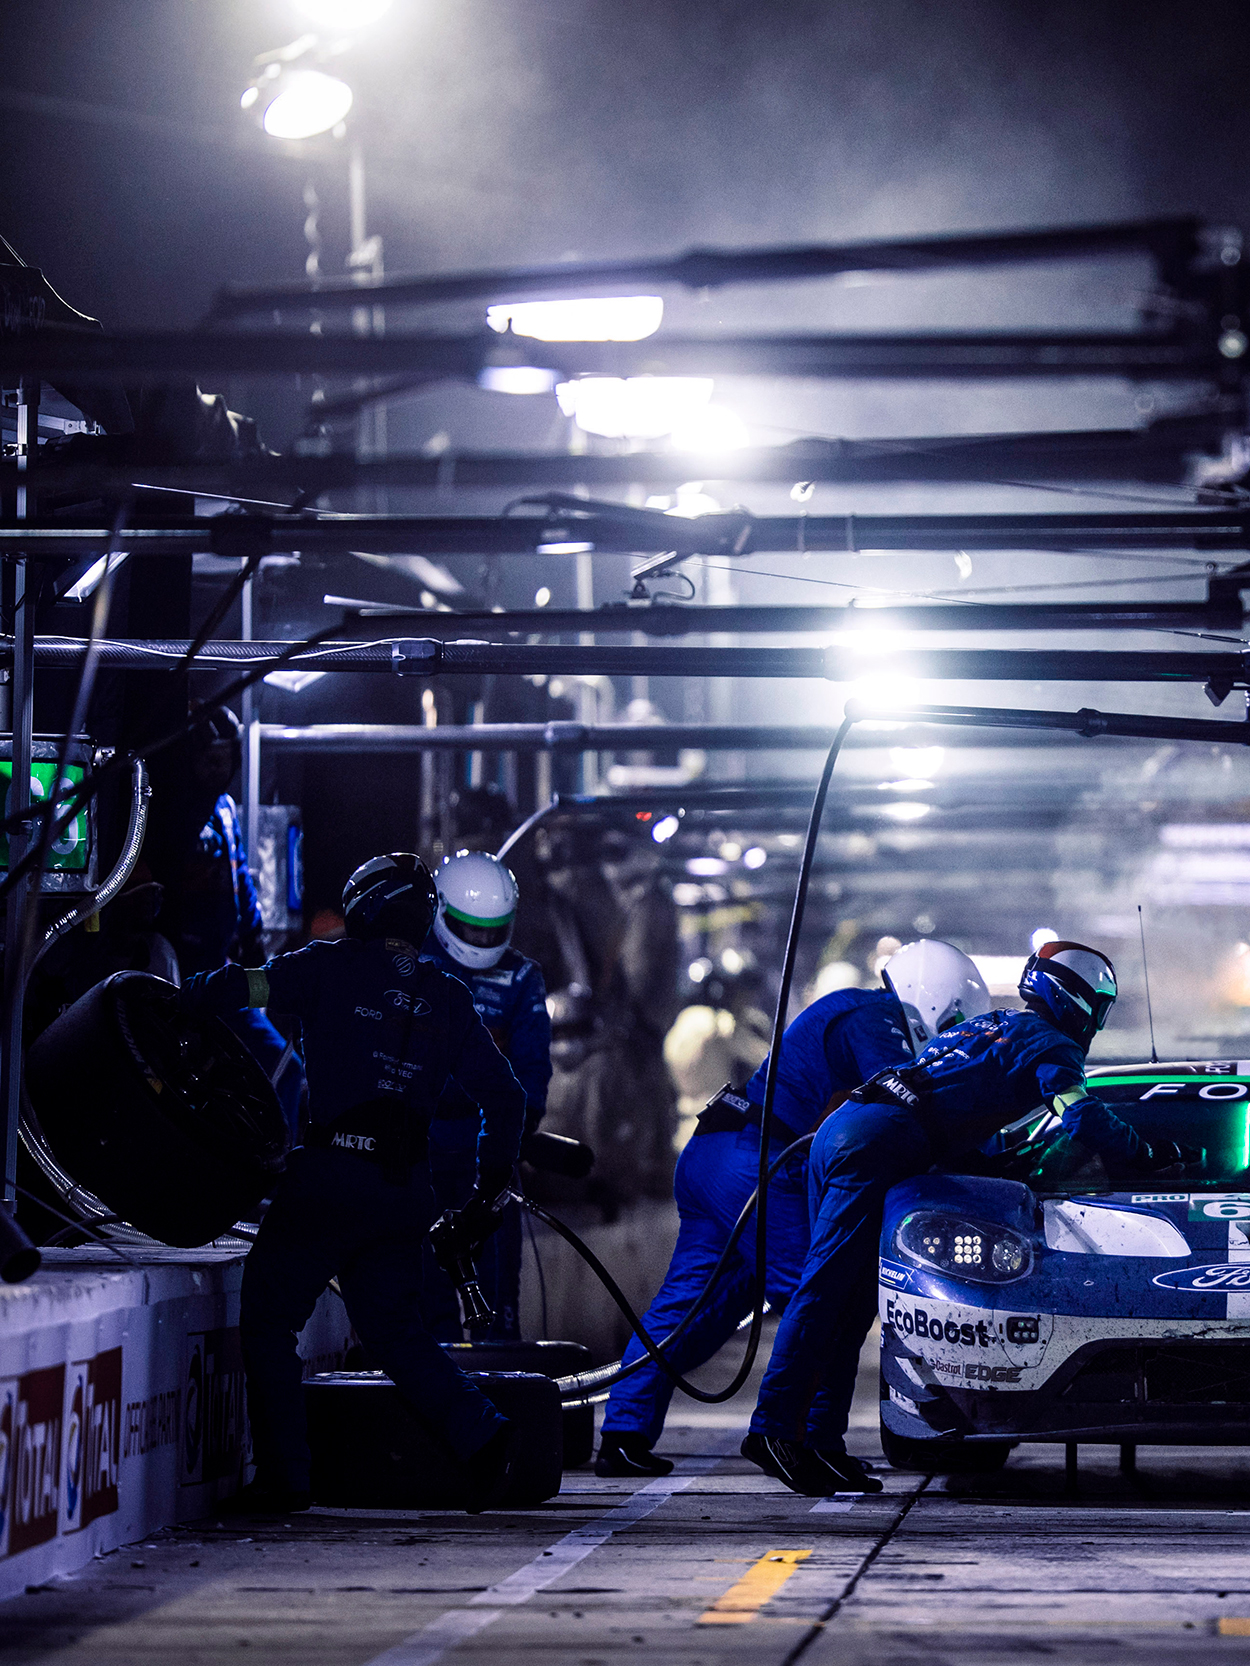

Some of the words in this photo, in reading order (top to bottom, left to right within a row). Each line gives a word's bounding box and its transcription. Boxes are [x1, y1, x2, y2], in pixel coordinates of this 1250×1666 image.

[354, 1006, 383, 1021] FORD
[1134, 1194, 1186, 1202] PRO
[886, 1299, 990, 1348] EcoBoost
[964, 1363, 1023, 1383] EDGE
